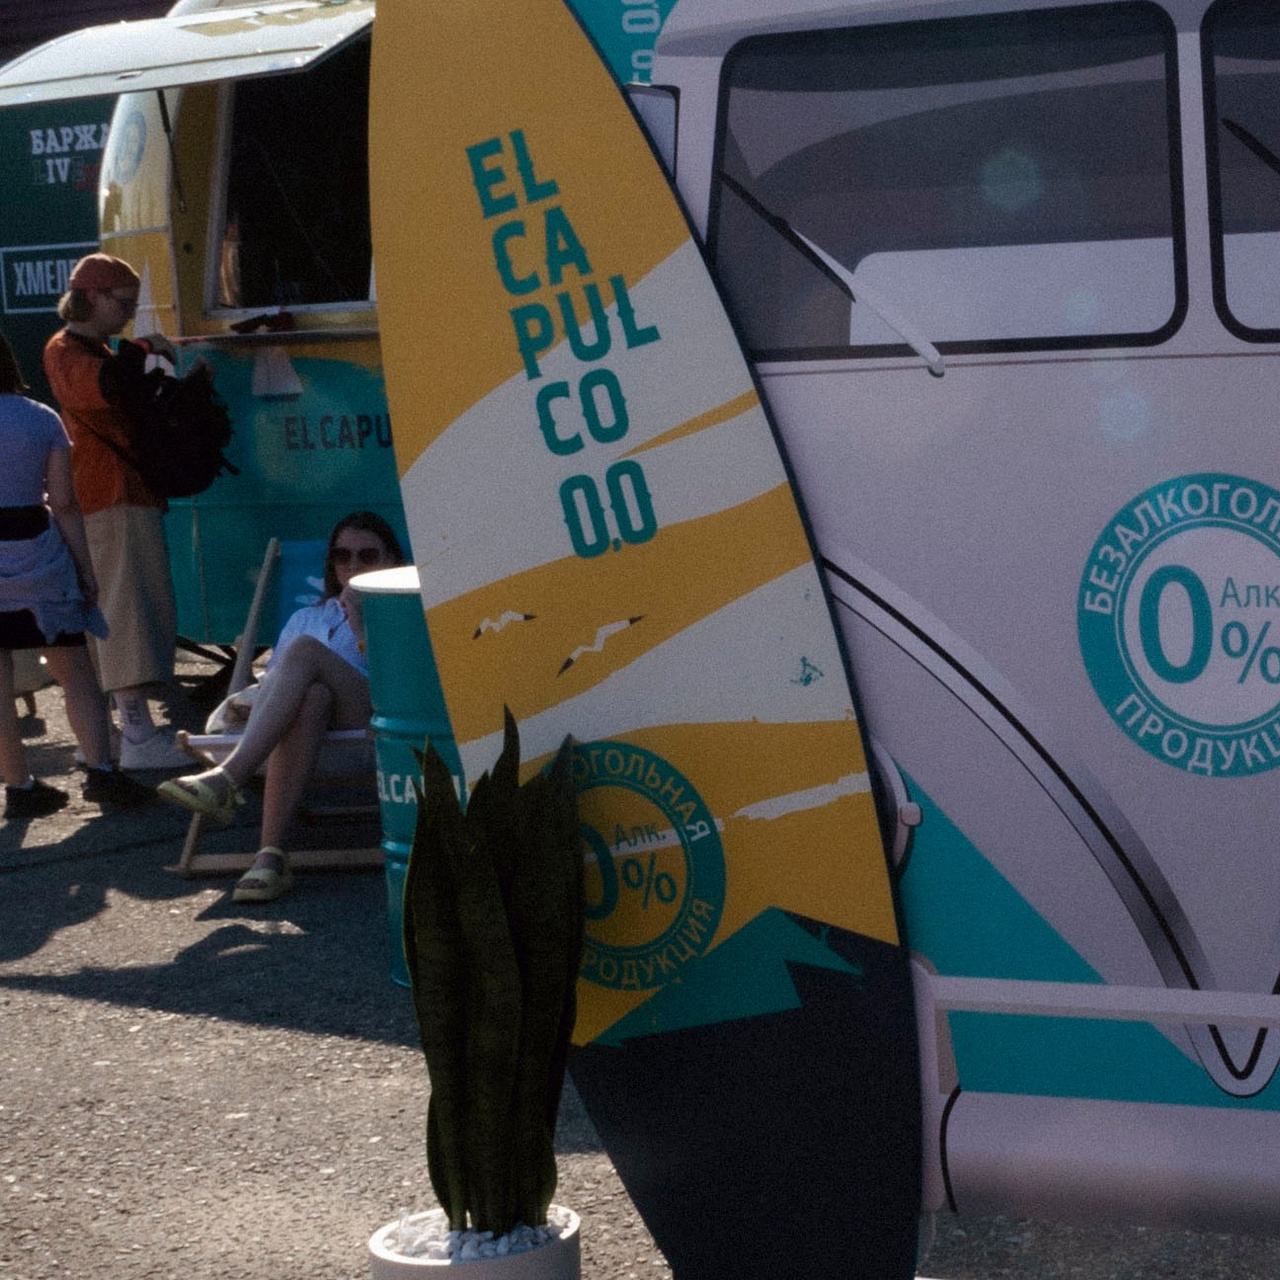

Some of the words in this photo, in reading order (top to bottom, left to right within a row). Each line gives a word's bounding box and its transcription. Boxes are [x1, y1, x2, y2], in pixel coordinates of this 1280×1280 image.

[465, 128, 560, 219] EL
[490, 205, 593, 297] CA
[508, 273, 662, 382] PUL
[284, 416, 316, 450] EL
[534, 367, 630, 457] CO
